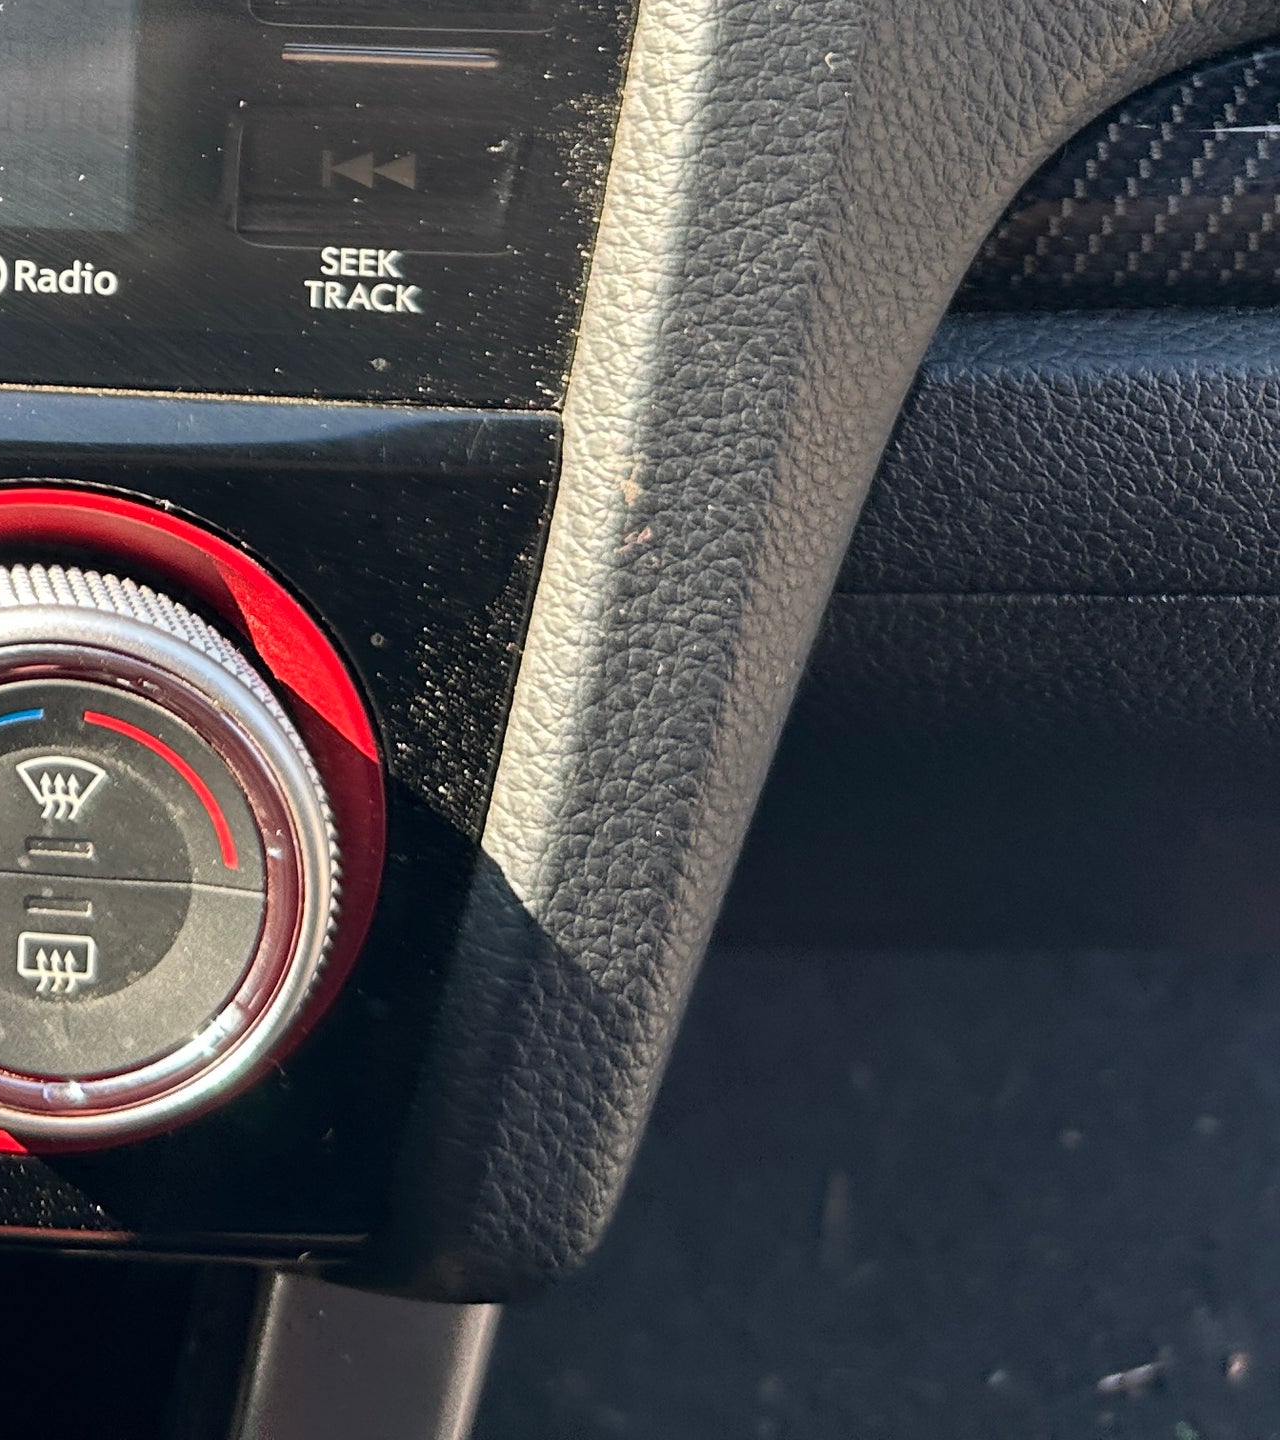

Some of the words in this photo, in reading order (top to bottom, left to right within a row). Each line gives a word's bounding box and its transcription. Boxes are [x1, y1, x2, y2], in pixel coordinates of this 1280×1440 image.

[13, 259, 118, 296] Radio
[320, 246, 402, 279] SEEK
[304, 279, 421, 314] TRACK
